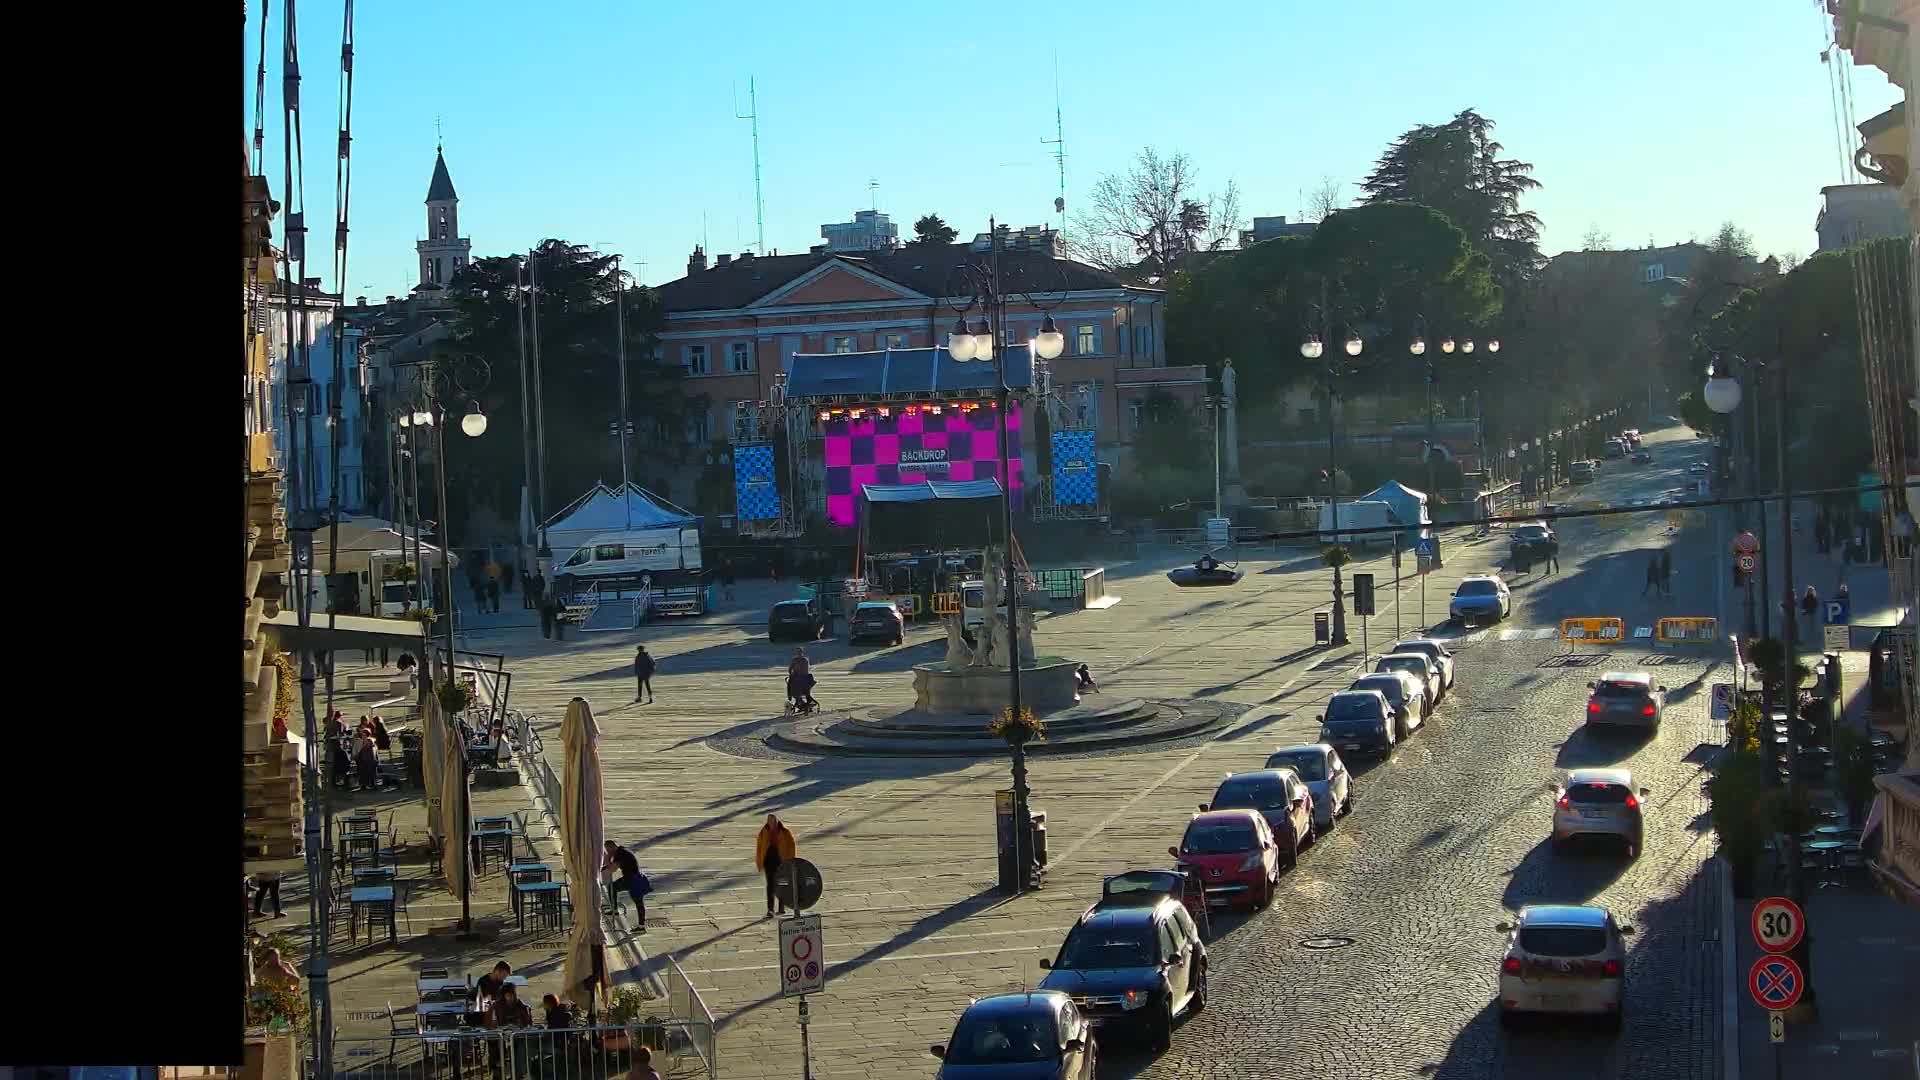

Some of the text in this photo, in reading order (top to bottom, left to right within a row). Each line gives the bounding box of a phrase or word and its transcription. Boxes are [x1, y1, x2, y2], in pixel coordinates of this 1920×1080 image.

[901, 450, 946, 461] BACKDROP
[1827, 602, 1842, 622] P
[1763, 911, 1791, 938] 30
